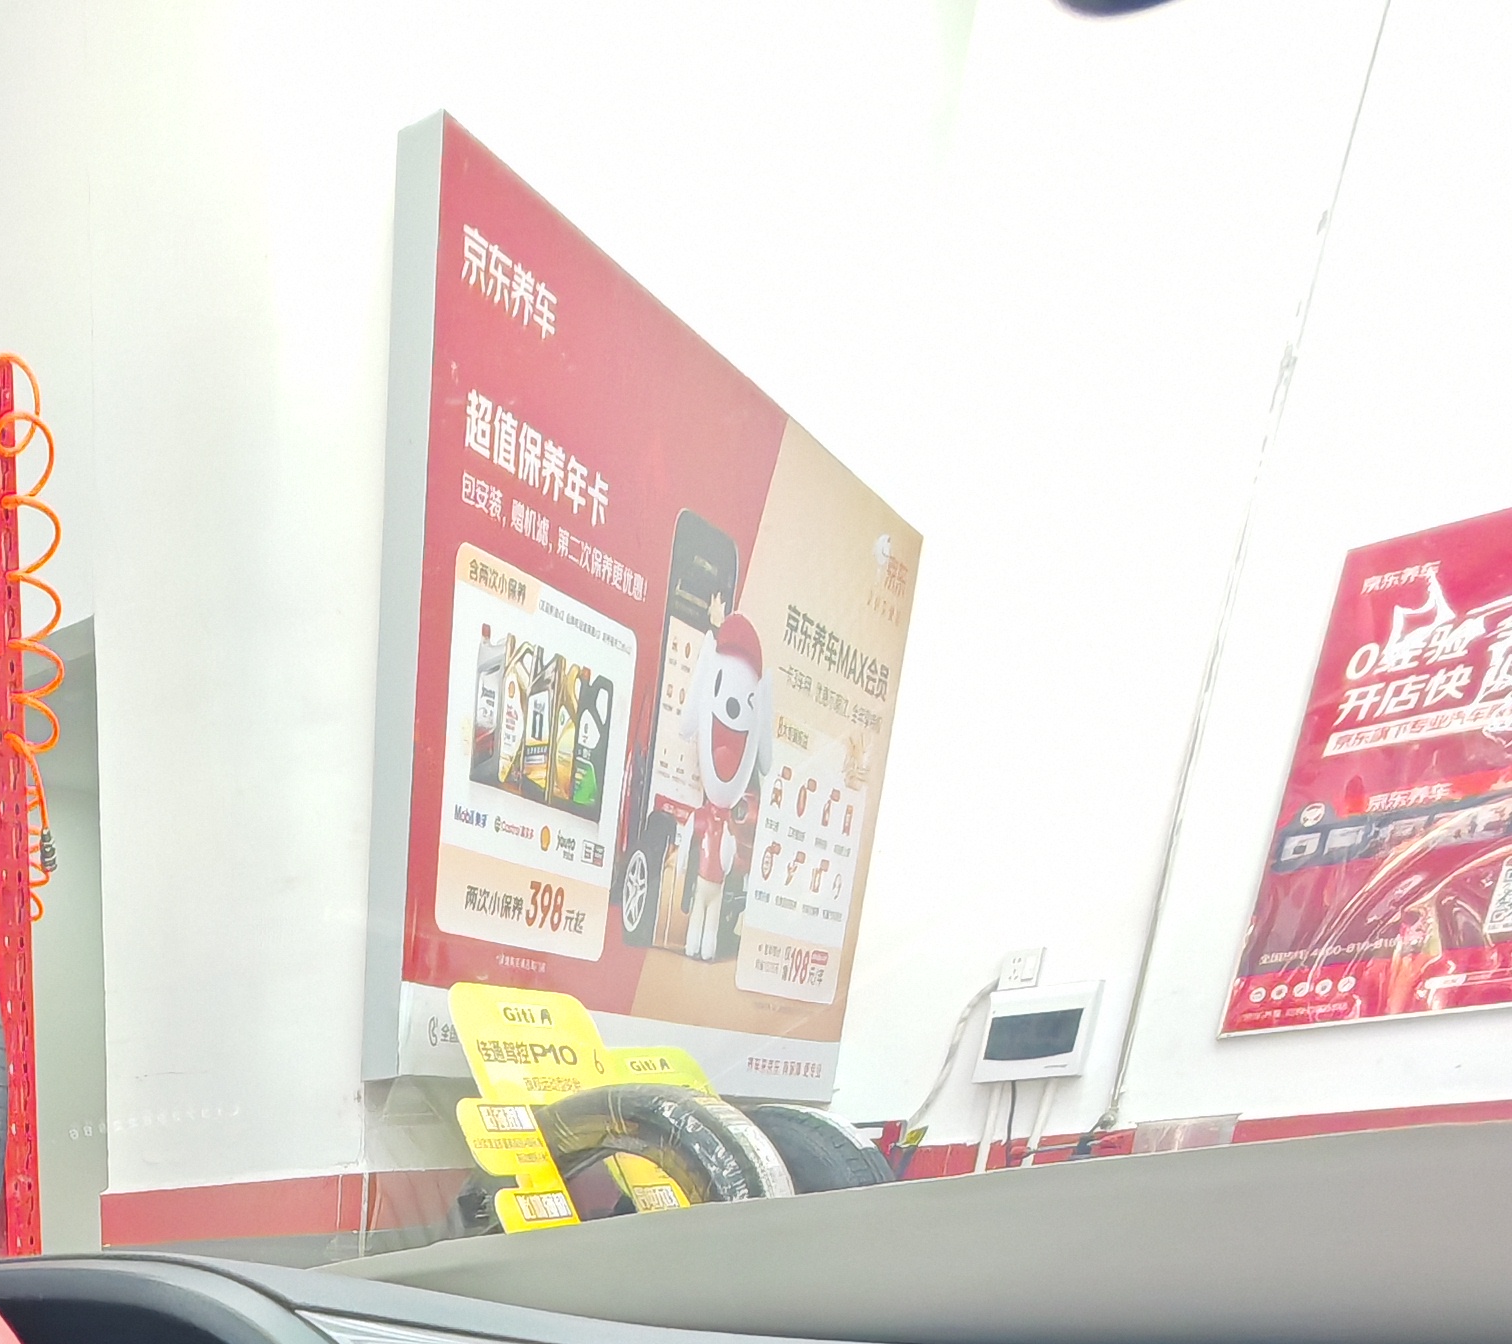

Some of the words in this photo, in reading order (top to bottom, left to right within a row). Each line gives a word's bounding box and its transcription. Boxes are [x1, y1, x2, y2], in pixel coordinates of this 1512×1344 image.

[461, 223, 558, 339] 京东养车
[464, 389, 609, 527] 超值保养年卡
[1333, 663, 1474, 727] 开店快
[503, 1006, 535, 1024] Giti
[630, 1057, 657, 1072] Giti
